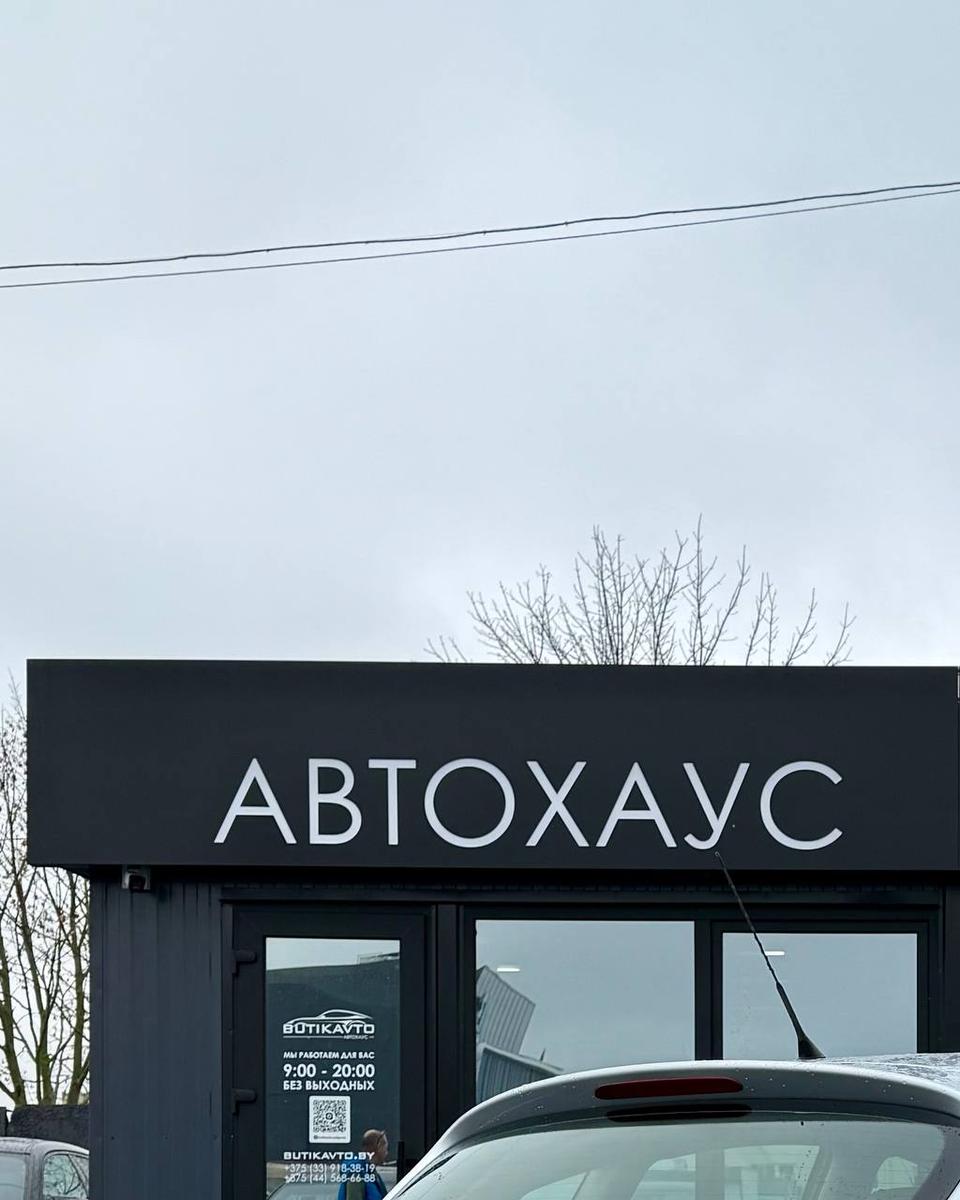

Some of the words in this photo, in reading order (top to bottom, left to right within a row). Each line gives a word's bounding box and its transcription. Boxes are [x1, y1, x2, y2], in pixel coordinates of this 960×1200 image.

[213, 757, 843, 851] АВТОХАУС
[283, 1023, 375, 1034] BUTIKAVTO
[283, 1051, 297, 1059] МЫ
[299, 1051, 339, 1059] РАБОТАЕМ
[341, 1051, 357, 1060] ДЛЯ
[359, 1051, 375, 1059] ВАС
[283, 1063, 316, 1078] 9:00
[332, 1063, 375, 1078] 20:00
[283, 1080, 302, 1090] БЕЗ
[305, 1080, 375, 1091] ВЫХОДНЫХ
[283, 1151, 375, 1160] BUTIKAVTO.BY
[309, 1163, 328, 1174] (33)
[330, 1163, 376, 1173] 918-38-19
[309, 1173, 328, 1184] (44)
[330, 1173, 376, 1183] 568-66-88
